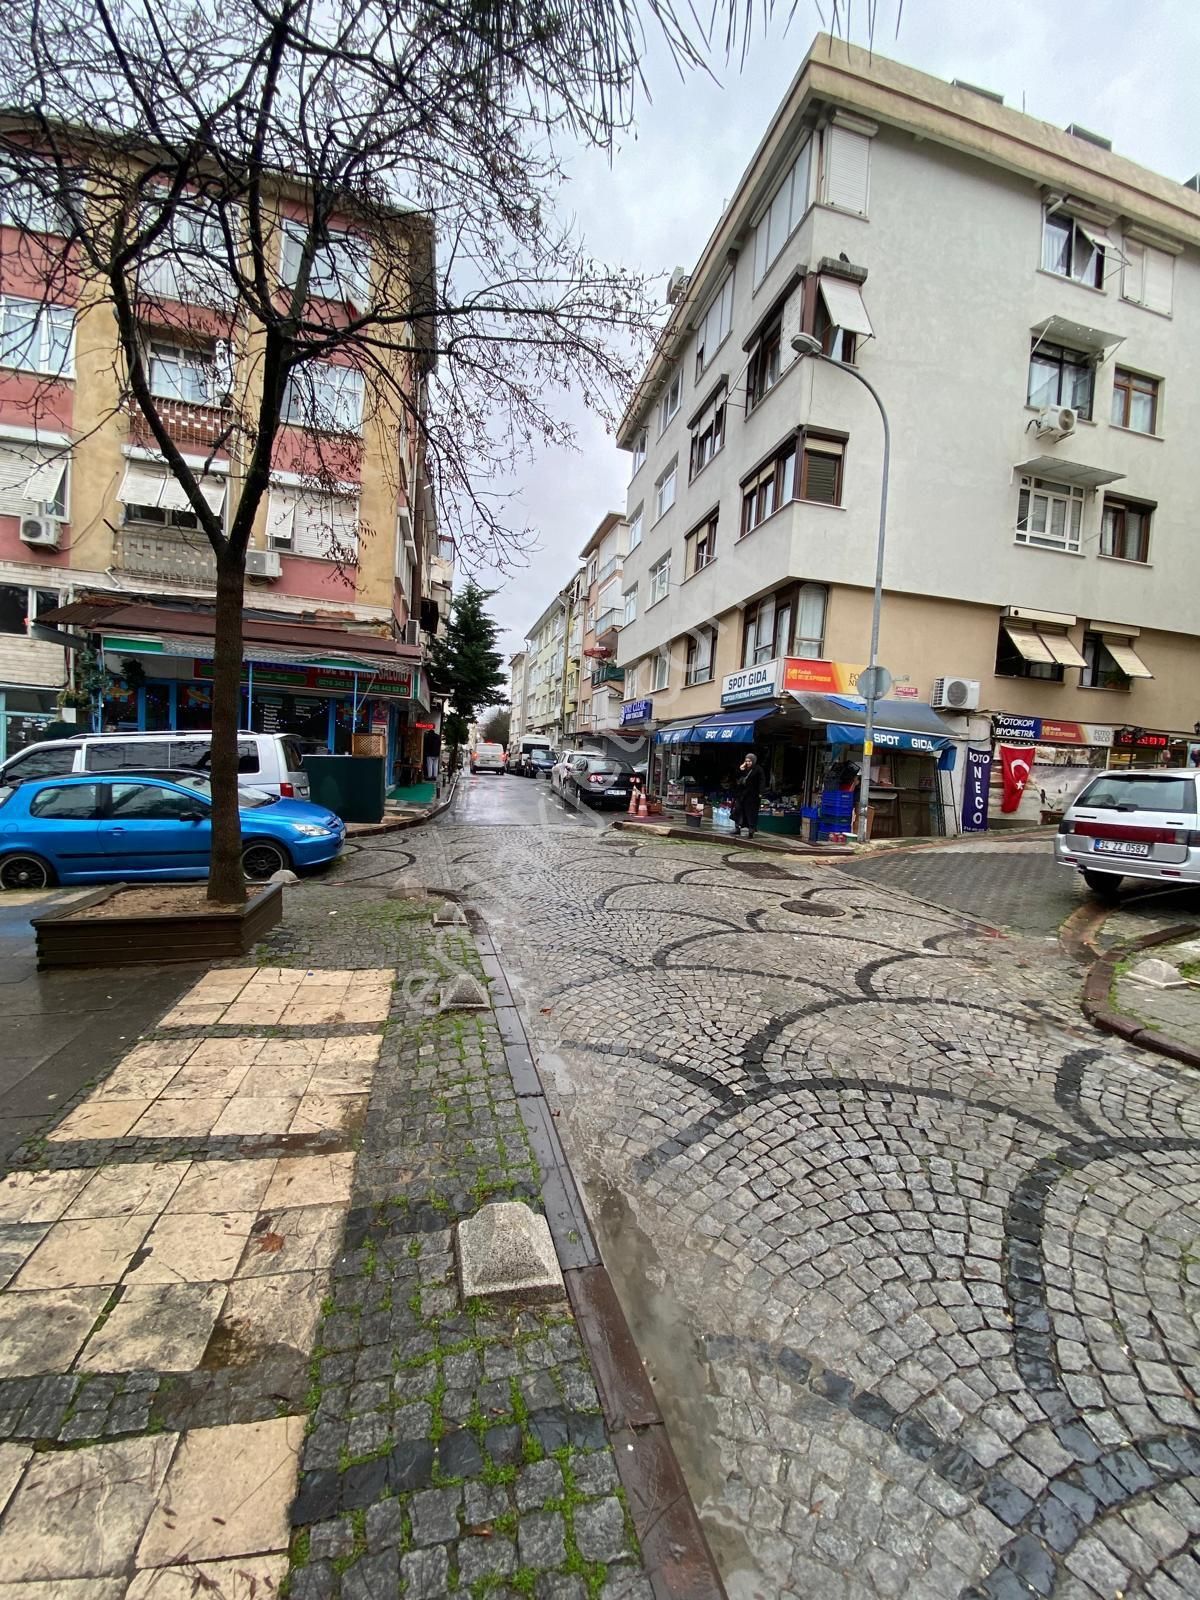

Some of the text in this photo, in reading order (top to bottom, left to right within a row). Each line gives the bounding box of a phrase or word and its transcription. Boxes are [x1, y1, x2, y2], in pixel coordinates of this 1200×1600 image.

[728, 669, 767, 690] SPOT GIDA
[705, 730, 718, 739] SPOT
[874, 733, 934, 751] SPOT GIDA
[1100, 840, 1146, 854] 34 ZZ 0582
